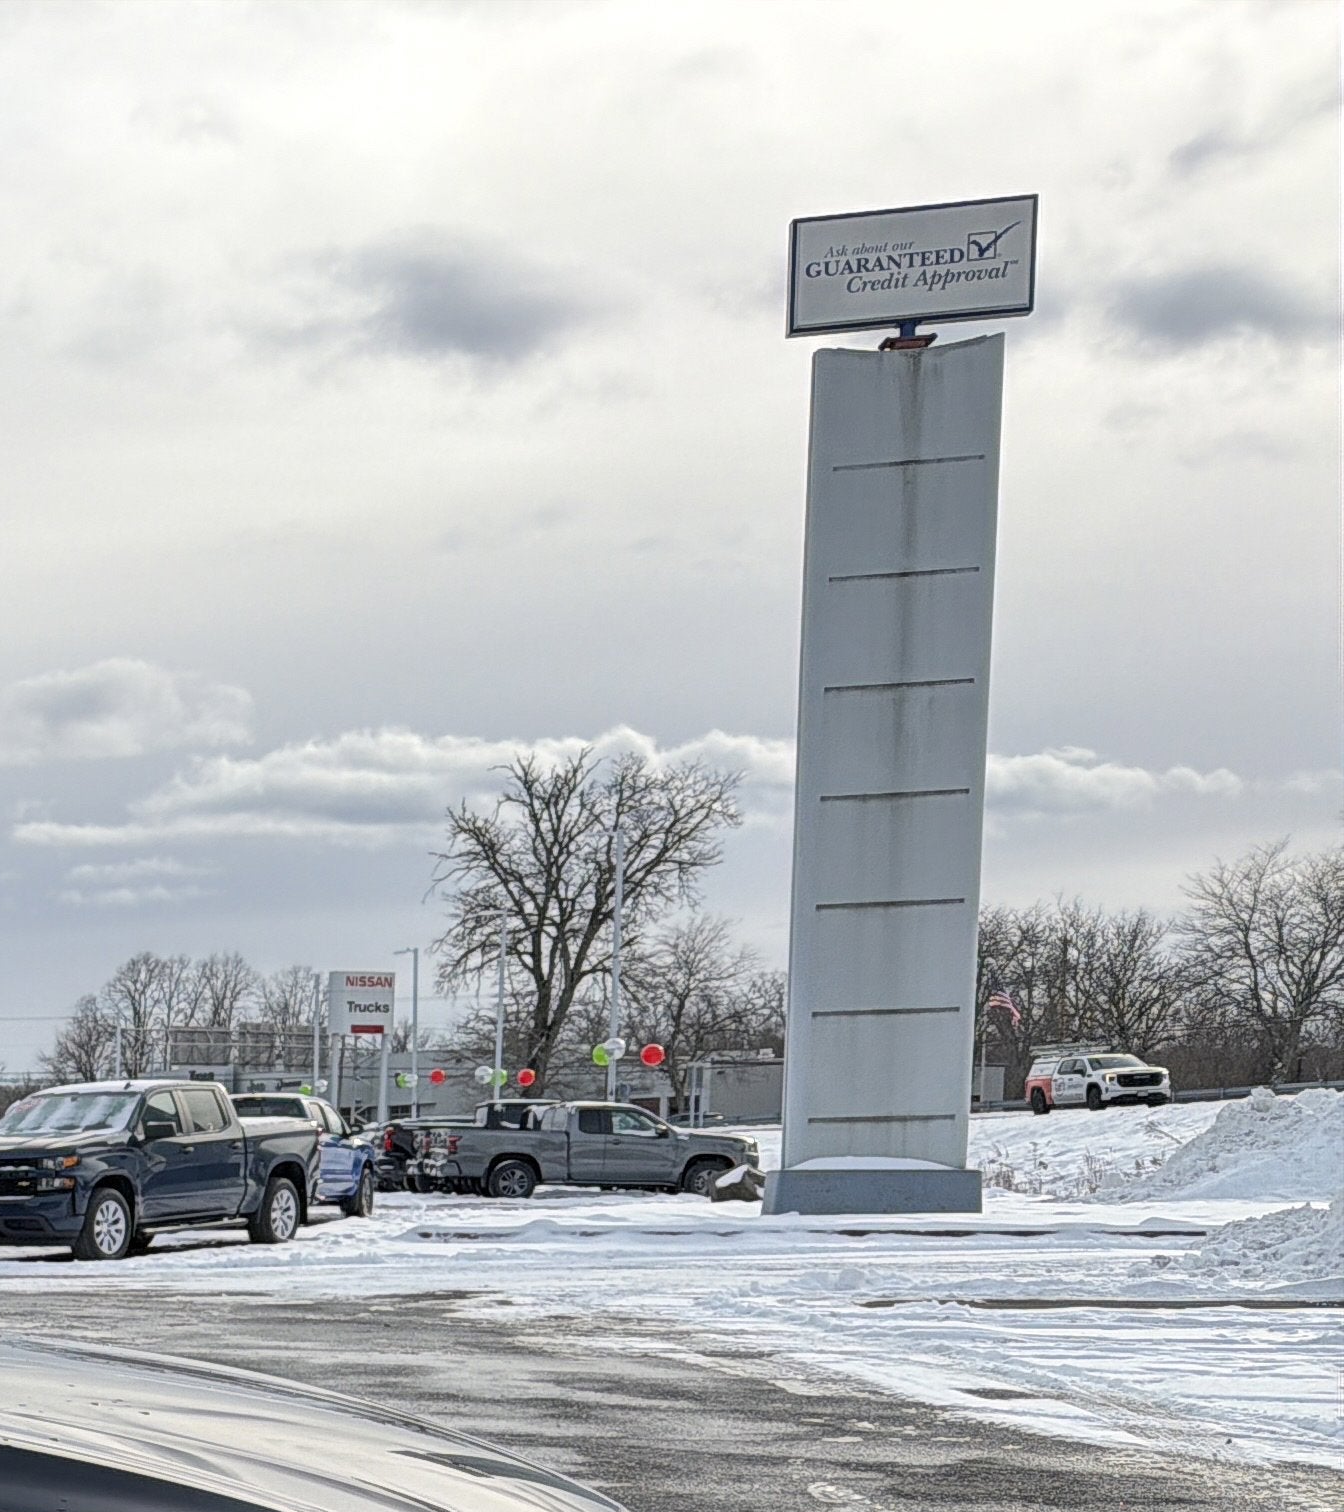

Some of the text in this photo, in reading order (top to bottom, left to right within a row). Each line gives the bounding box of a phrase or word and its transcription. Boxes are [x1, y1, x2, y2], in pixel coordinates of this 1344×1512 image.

[824, 240, 915, 259] Ask about our
[805, 247, 965, 279] GUARANTEED
[846, 271, 909, 294] Credit
[345, 975, 393, 988] NISSAN
[347, 1000, 390, 1014] Trucks
